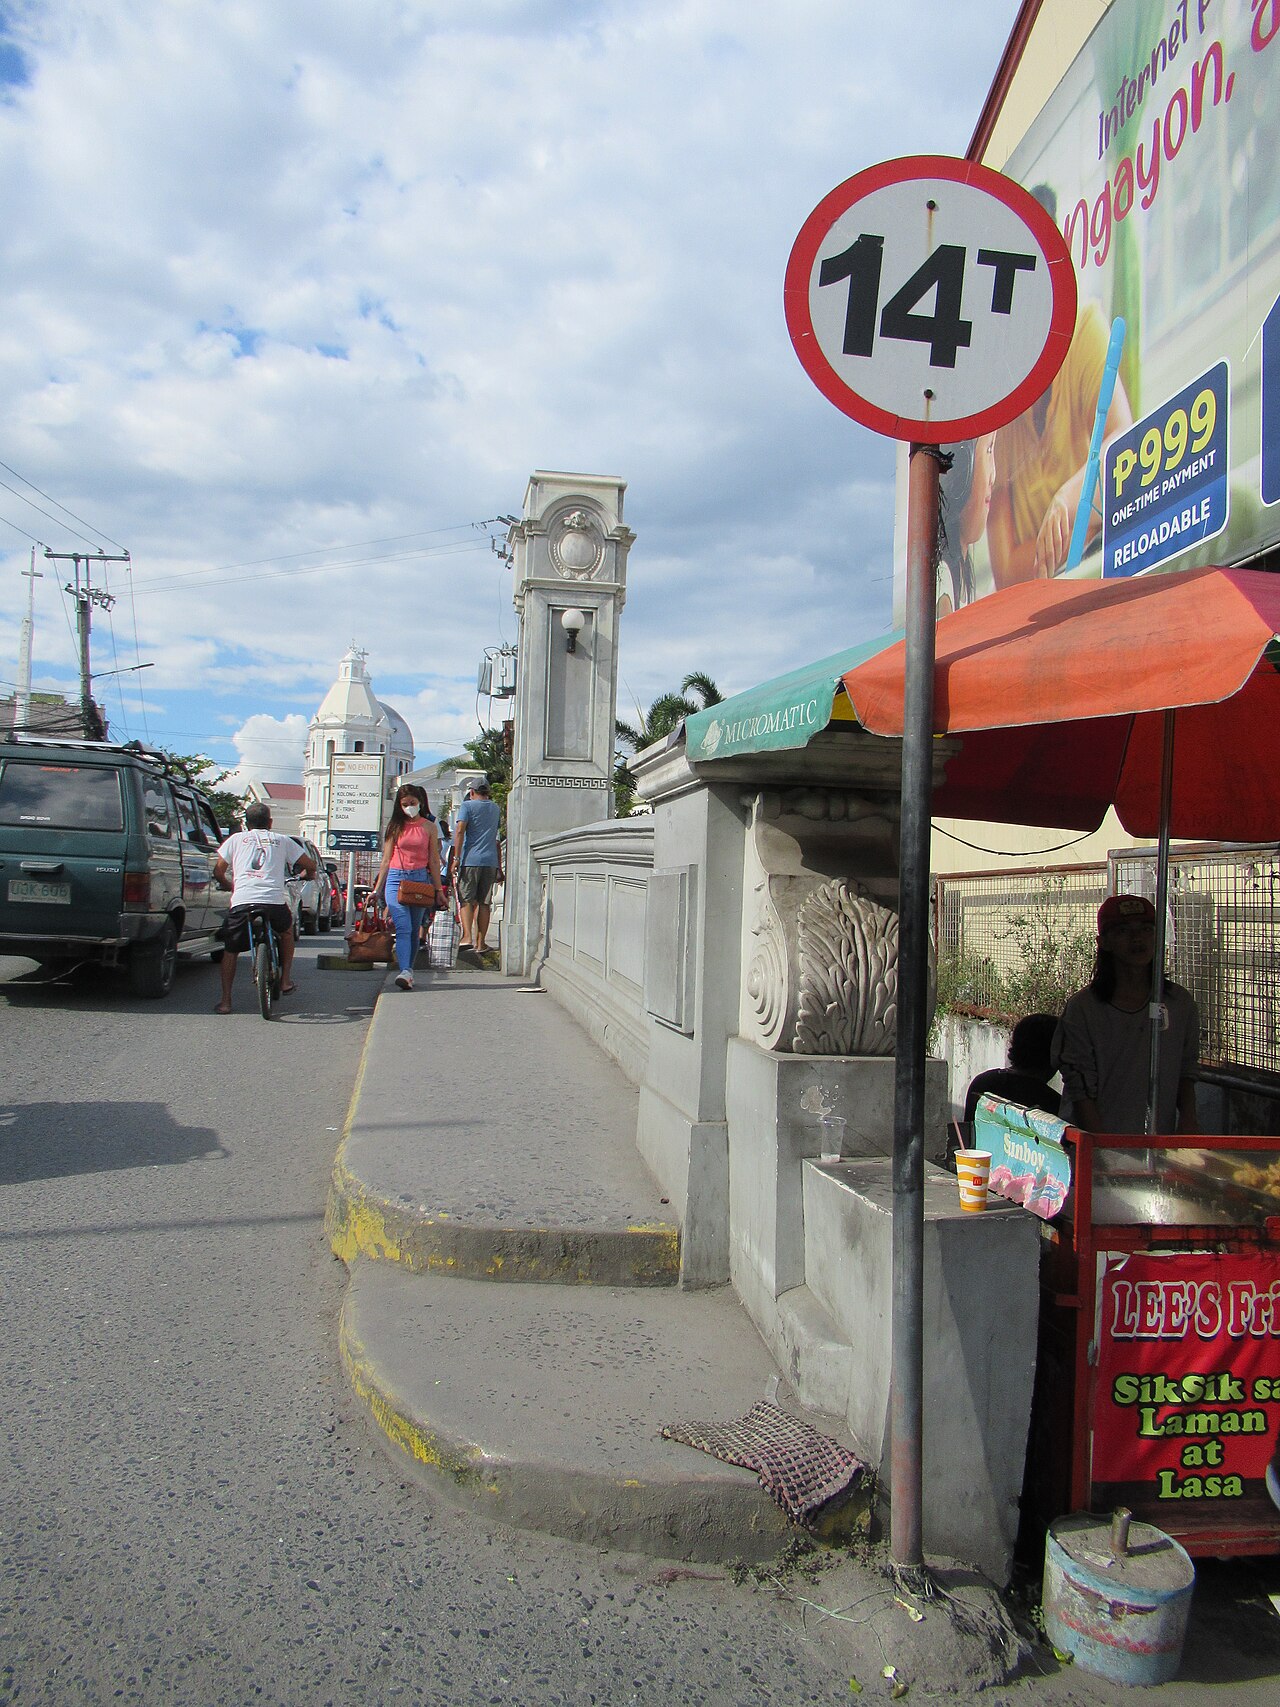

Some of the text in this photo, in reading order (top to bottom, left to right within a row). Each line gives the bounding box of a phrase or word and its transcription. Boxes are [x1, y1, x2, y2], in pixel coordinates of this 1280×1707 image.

[1098, 0, 1189, 160] Internet
[1111, 449, 1217, 527] ONE-TIME PAYMENT
[1113, 497, 1211, 569] RELOADABLE
[723, 699, 817, 745] MICROMATIC
[358, 763, 378, 771] ENTRY
[1111, 1279, 1222, 1339] LEE'S
[1139, 1407, 1267, 1436] Laman
[1182, 1439, 1222, 1466] at
[1157, 1470, 1244, 1499] Lasa
